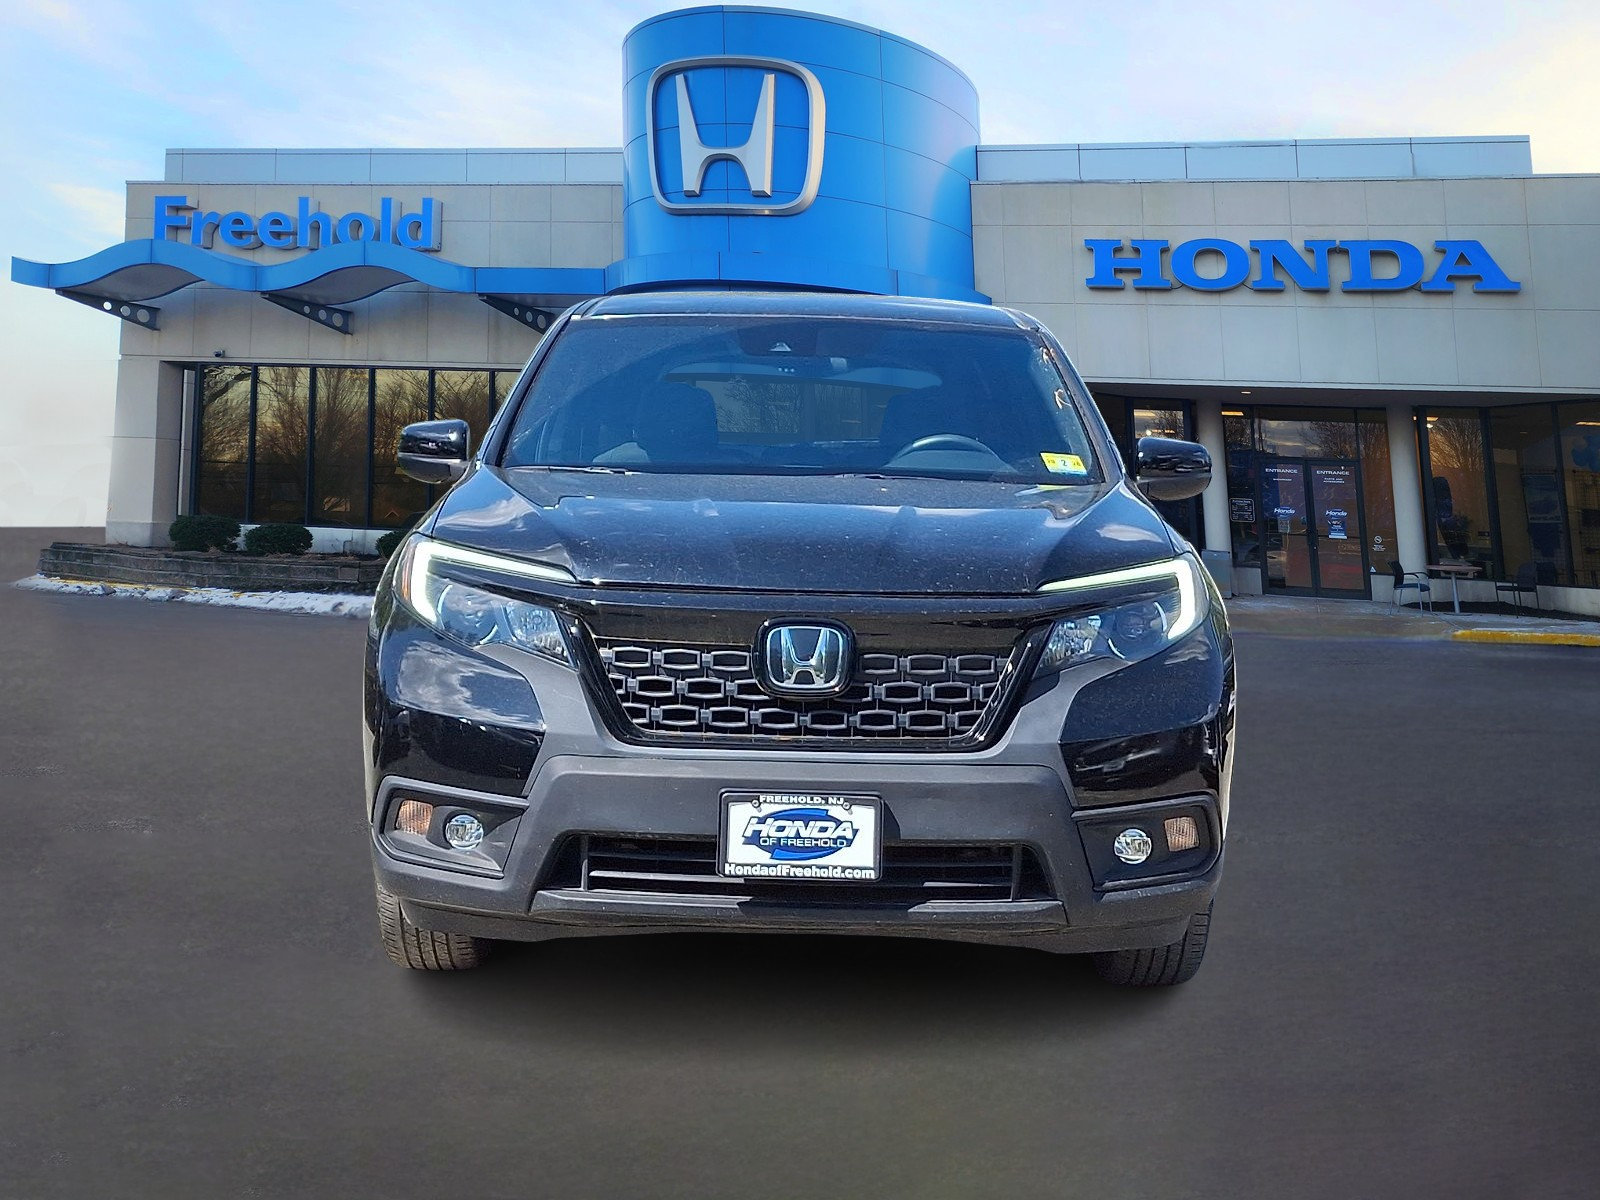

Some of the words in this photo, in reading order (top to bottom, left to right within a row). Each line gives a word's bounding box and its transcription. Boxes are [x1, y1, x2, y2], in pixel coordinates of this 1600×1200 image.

[154, 195, 442, 250] Freehold
[1084, 238, 1521, 293] HONDA
[828, 797, 844, 805] NJ
[743, 816, 854, 839] HONDA
[760, 837, 777, 846] OF
[780, 839, 847, 847] FREEHOLD
[724, 863, 875, 879] HondaofFreehold.com
